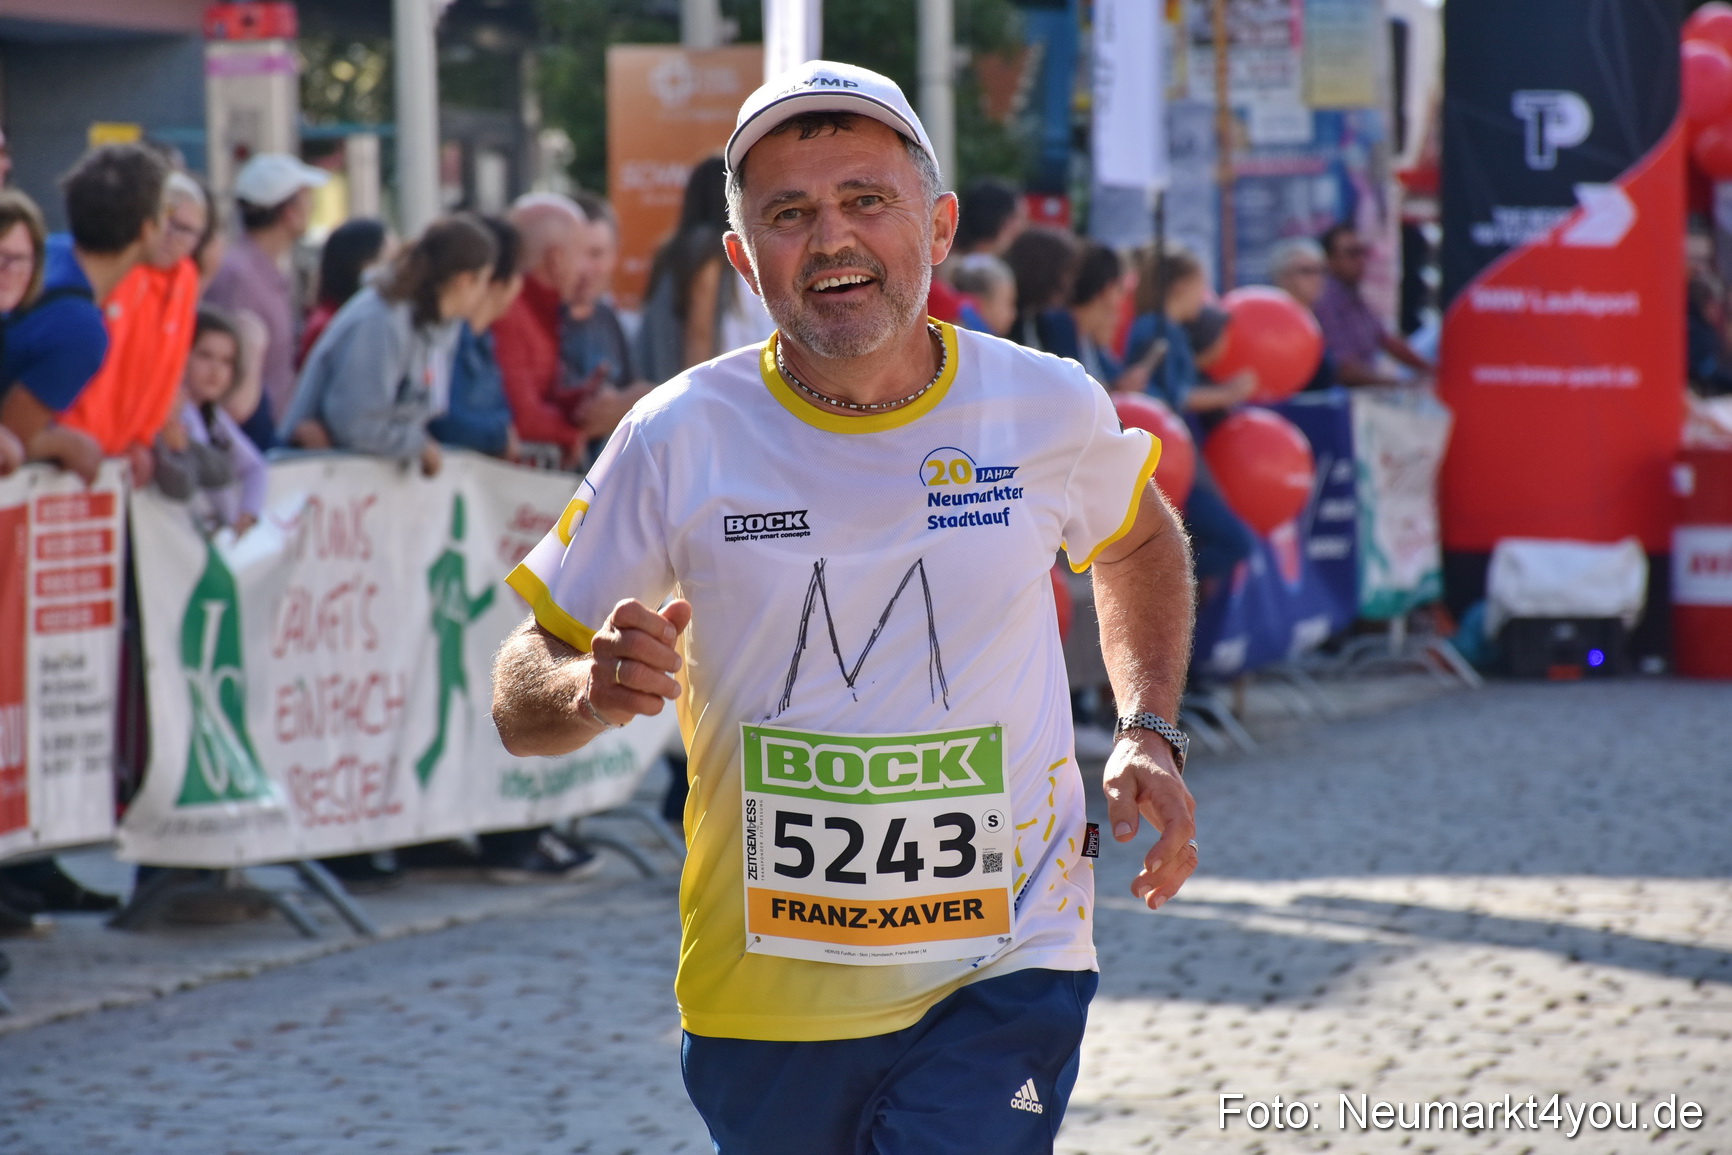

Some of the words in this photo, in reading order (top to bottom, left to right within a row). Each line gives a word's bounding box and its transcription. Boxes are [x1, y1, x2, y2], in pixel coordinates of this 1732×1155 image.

[926, 459, 972, 486] 20
[927, 486, 1023, 507] Neumarkter
[724, 510, 810, 535] BOCK
[927, 507, 1010, 529] Stadtlauf
[725, 534, 749, 542] inspired
[780, 530, 811, 539] concepts
[777, 557, 950, 718] M
[760, 736, 986, 795] BOCK
[988, 815, 999, 827] S
[774, 810, 977, 884] 5243
[772, 898, 985, 929] FRANZ-XAVER
[1010, 1098, 1043, 1115] adidas
